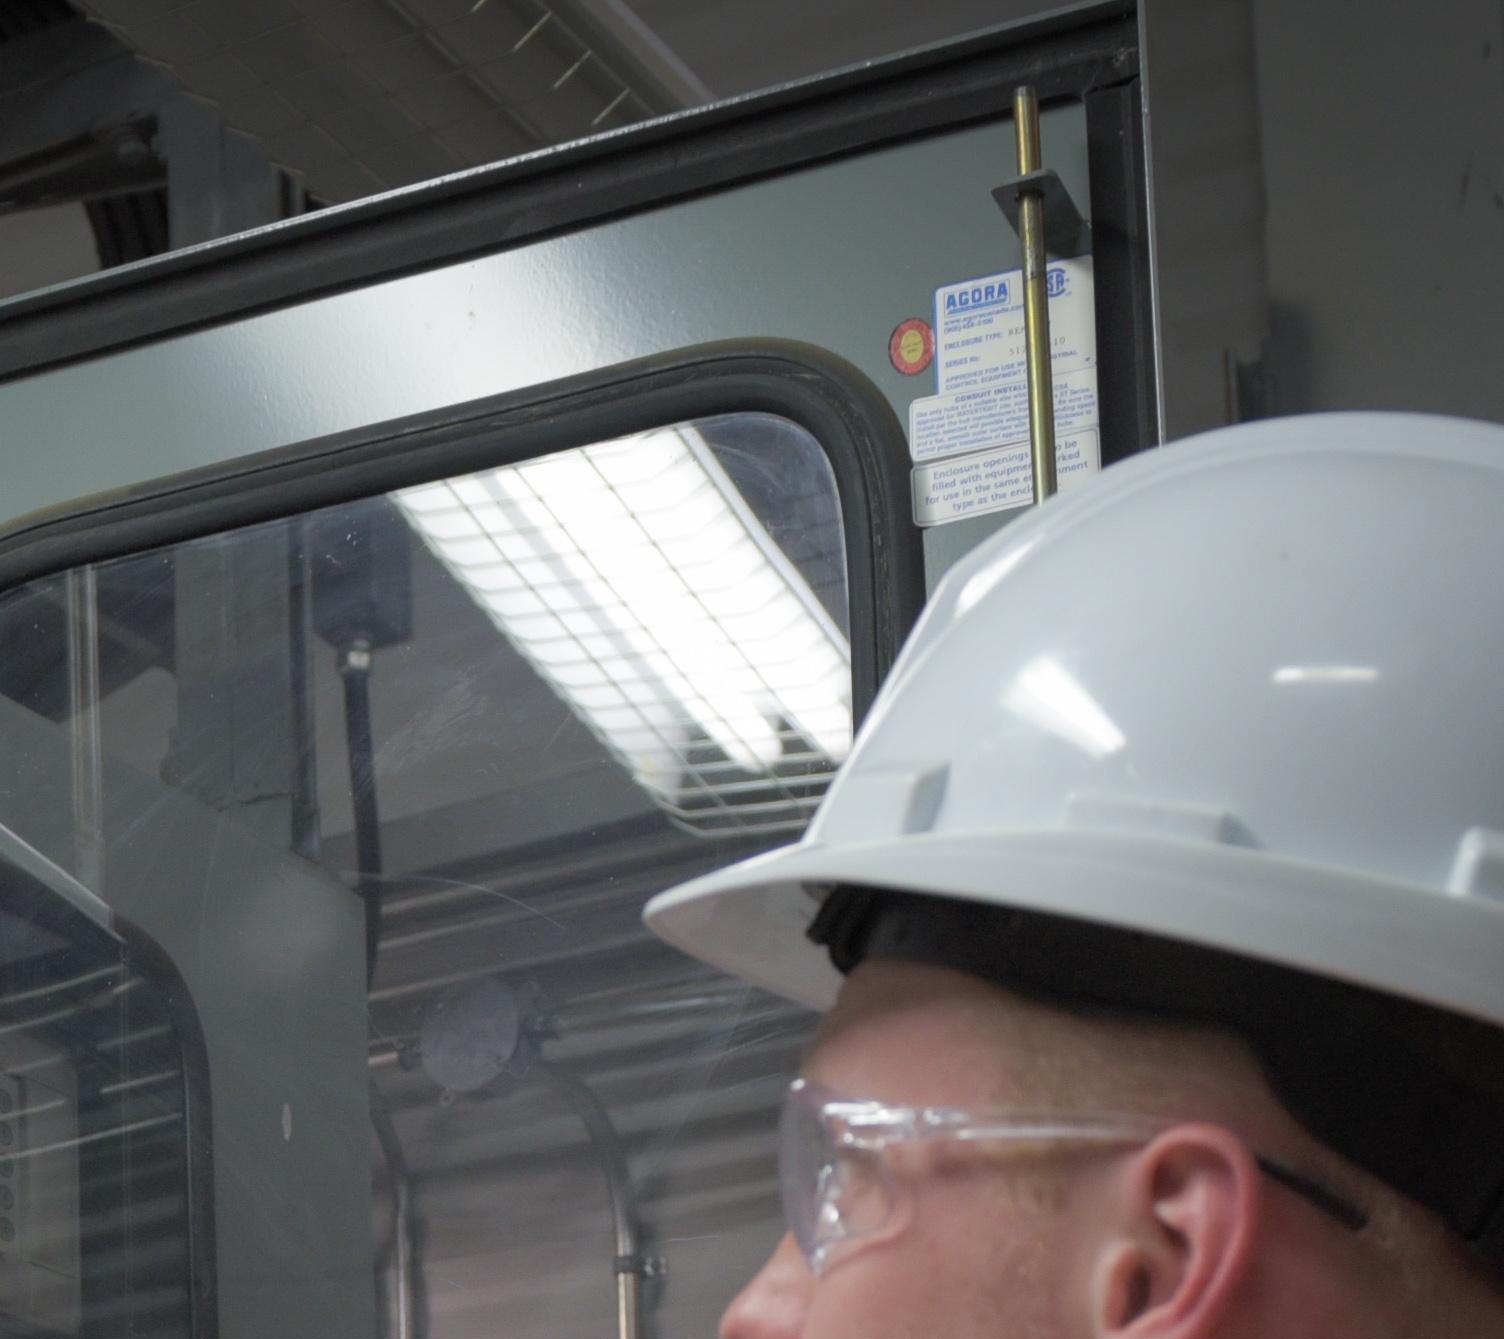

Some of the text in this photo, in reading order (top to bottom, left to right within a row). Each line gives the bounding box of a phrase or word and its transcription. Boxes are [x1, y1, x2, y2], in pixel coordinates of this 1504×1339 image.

[945, 281, 1009, 310] AGORA
[933, 439, 1078, 480] Enclosure openings be
[931, 460, 1032, 493] filled with equipmen
[924, 477, 1021, 506] for use in the same
[952, 490, 1008, 513] type as the
